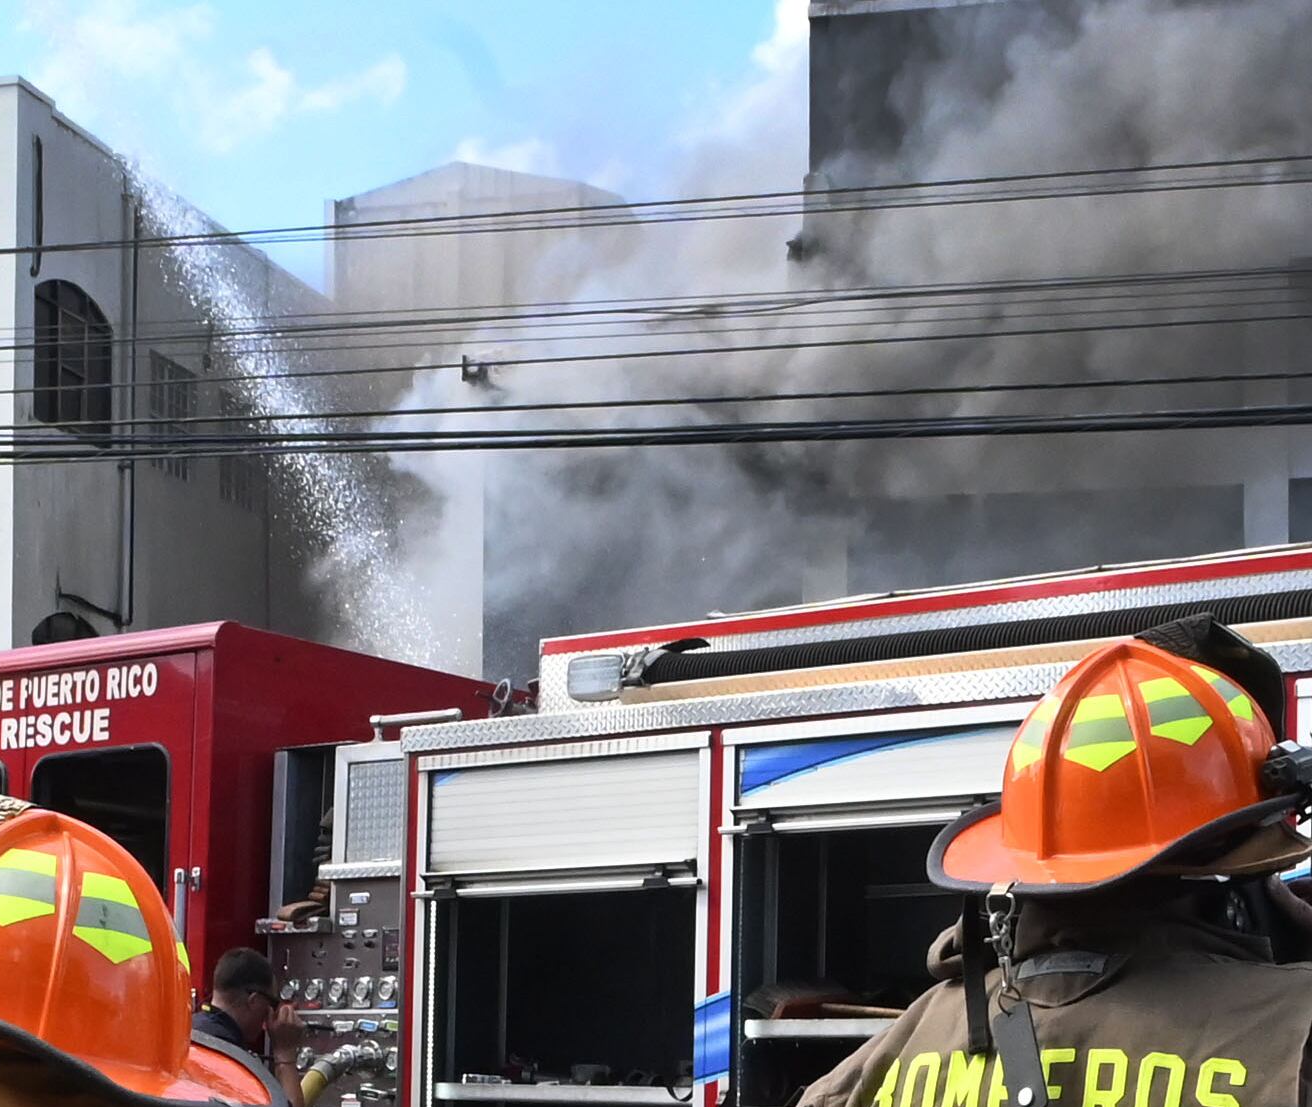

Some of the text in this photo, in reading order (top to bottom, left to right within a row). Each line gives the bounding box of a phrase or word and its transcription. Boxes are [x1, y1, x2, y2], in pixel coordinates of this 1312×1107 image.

[19, 669, 100, 710] PUERTO
[106, 662, 158, 701] RICO
[0, 707, 110, 751] RESCUE
